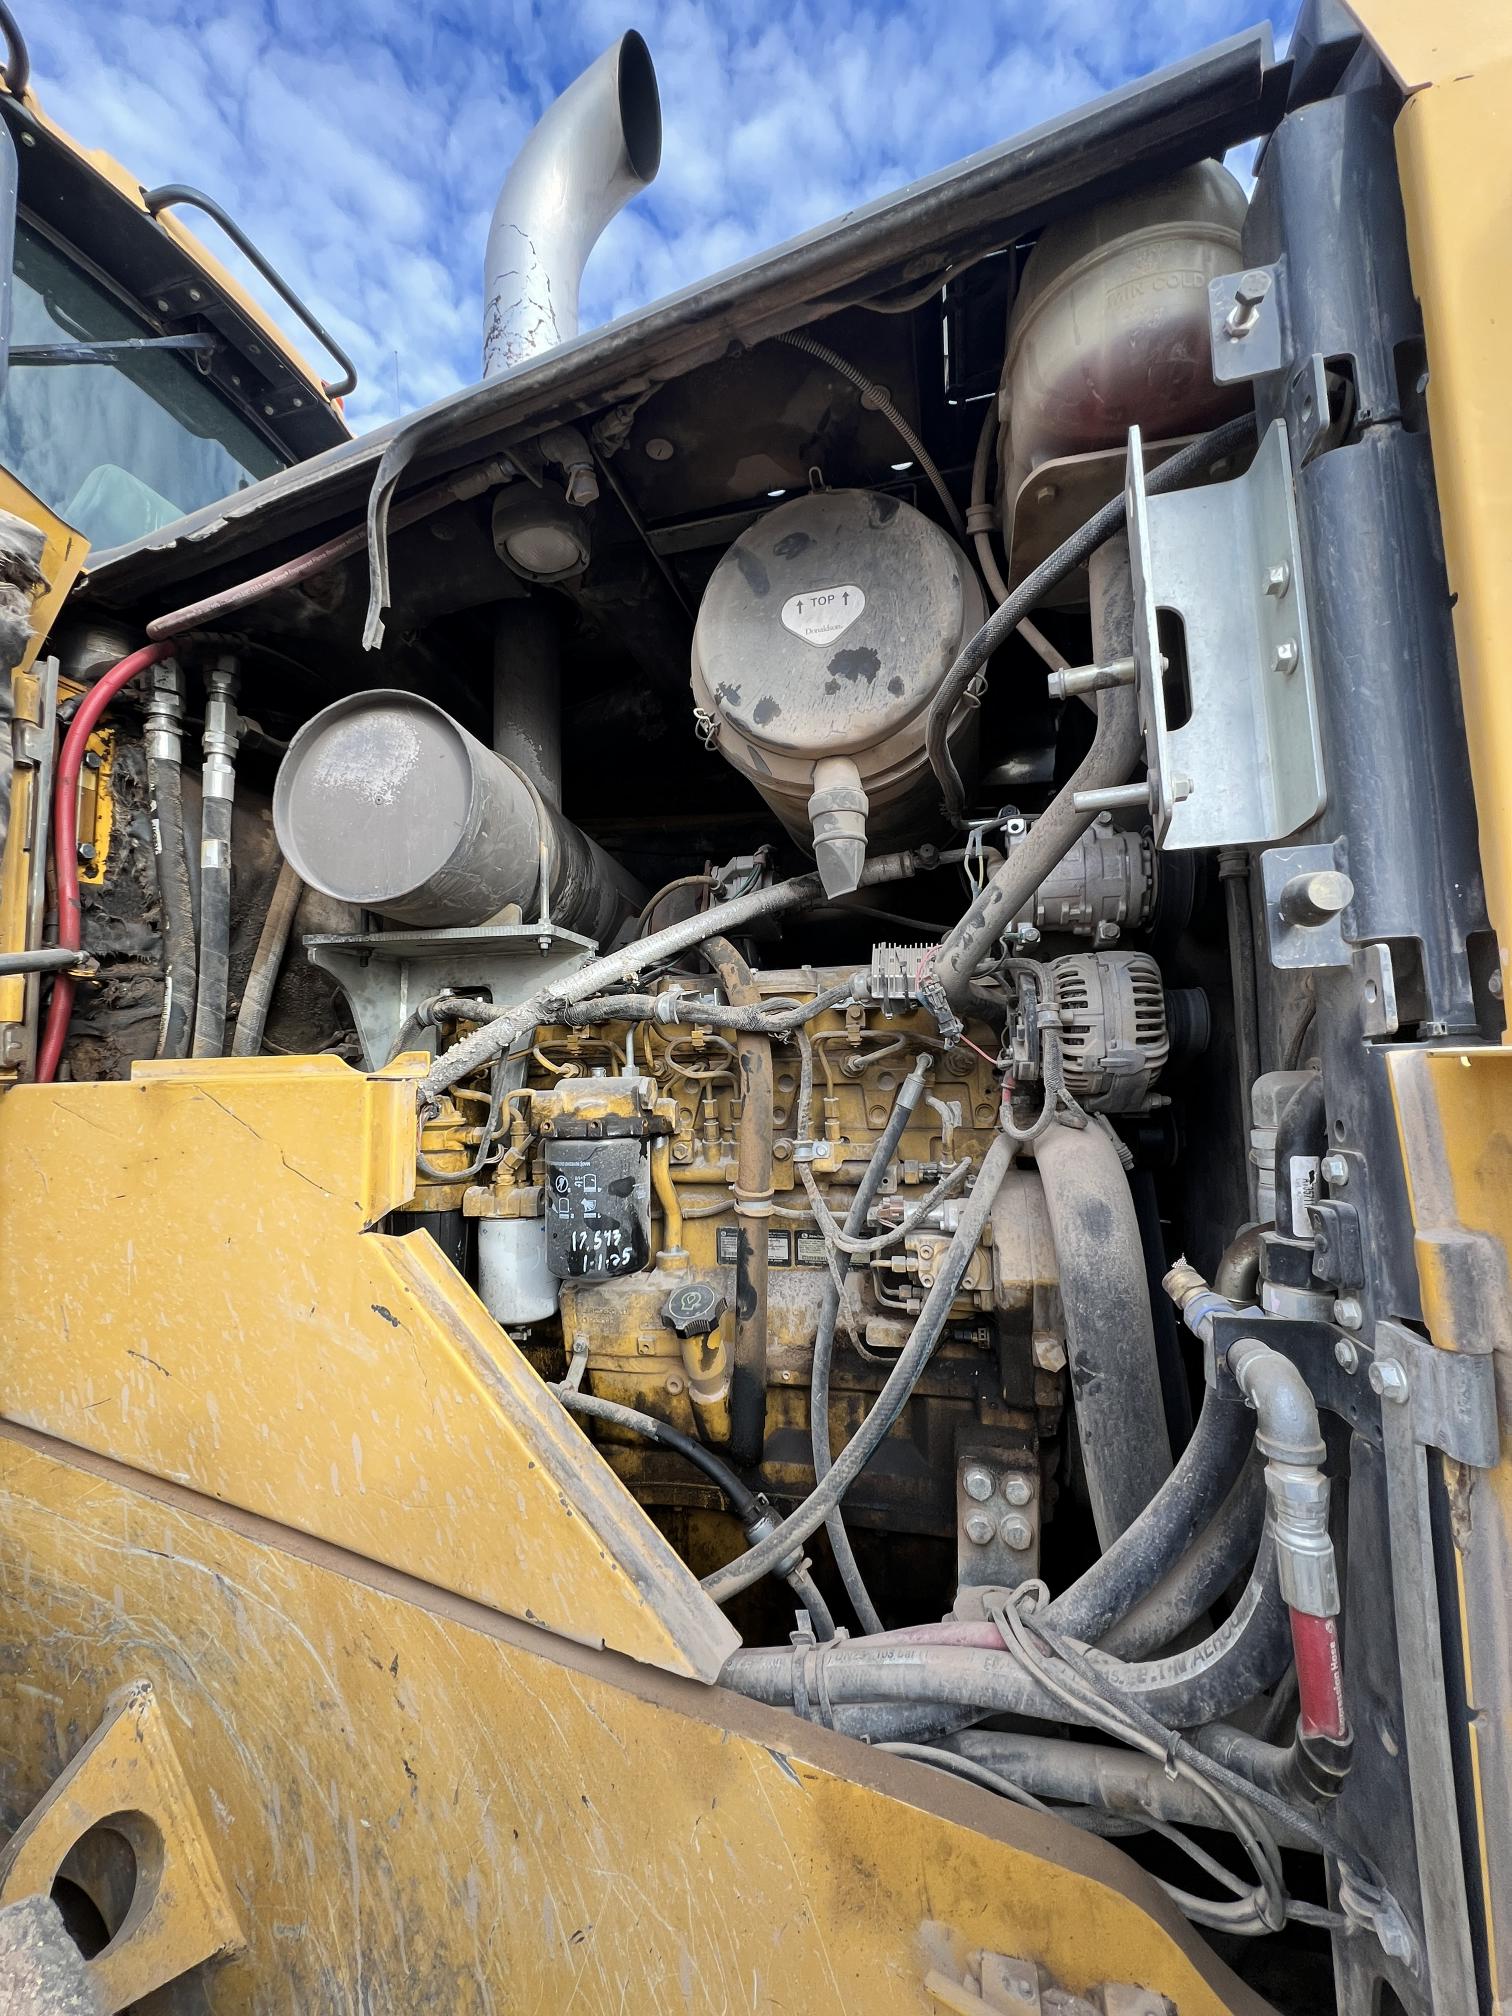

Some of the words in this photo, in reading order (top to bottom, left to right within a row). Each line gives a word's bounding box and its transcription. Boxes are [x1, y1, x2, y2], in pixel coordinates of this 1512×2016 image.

[1152, 271, 1205, 292] COLD
[810, 594, 835, 607] TOP
[1329, 1641, 1338, 1671] Hose
